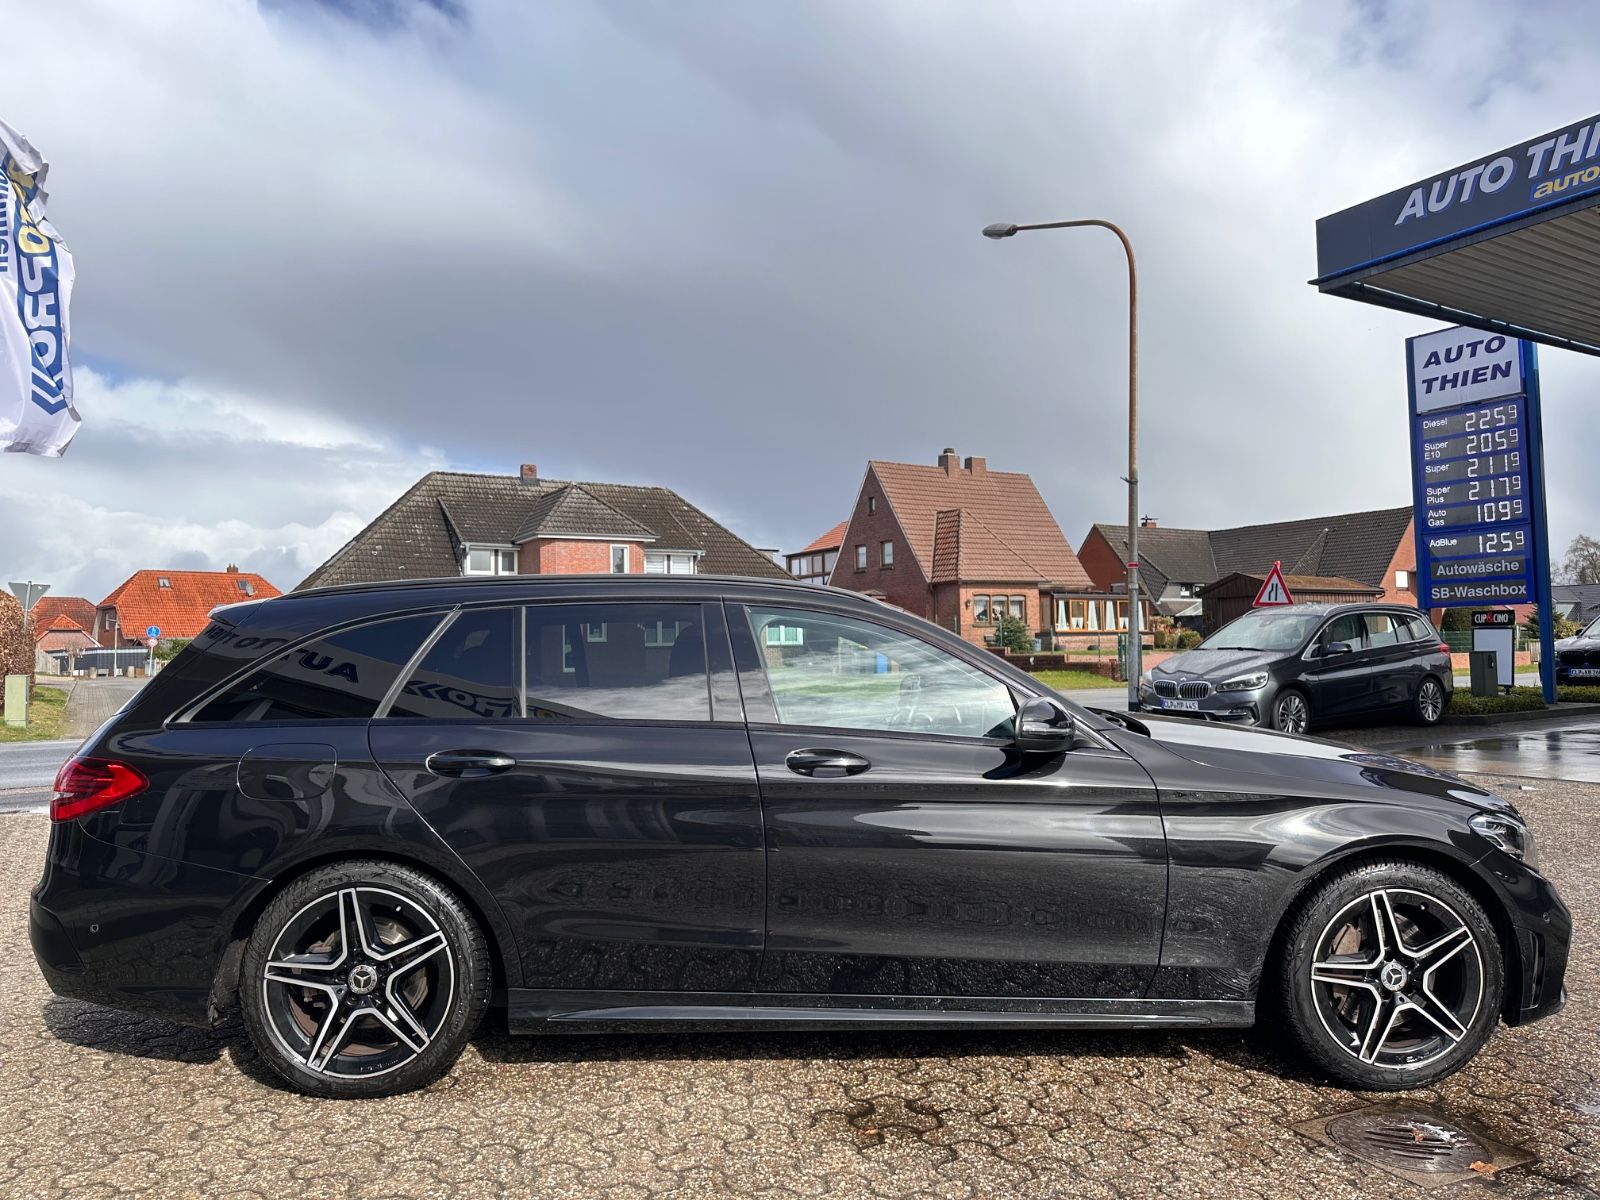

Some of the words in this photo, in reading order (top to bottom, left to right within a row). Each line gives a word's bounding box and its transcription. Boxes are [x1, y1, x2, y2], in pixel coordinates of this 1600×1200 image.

[1394, 156, 1515, 226] AUTO
[1422, 335, 1506, 369] AUTO
[1421, 360, 1513, 394] THIEN
[1423, 417, 1448, 429] Diesel
[1424, 441, 1449, 452] Super
[1424, 450, 1441, 460] E10
[1425, 464, 1450, 475] Super
[1426, 485, 1451, 496] Super
[1426, 495, 1445, 505] Plus
[1428, 508, 1447, 518] Auto
[1428, 518, 1445, 527] Gas
[1429, 538, 1458, 548] AdBlue
[1436, 560, 1520, 576] Autowäsche
[1431, 583, 1527, 599] SB-Waschbox
